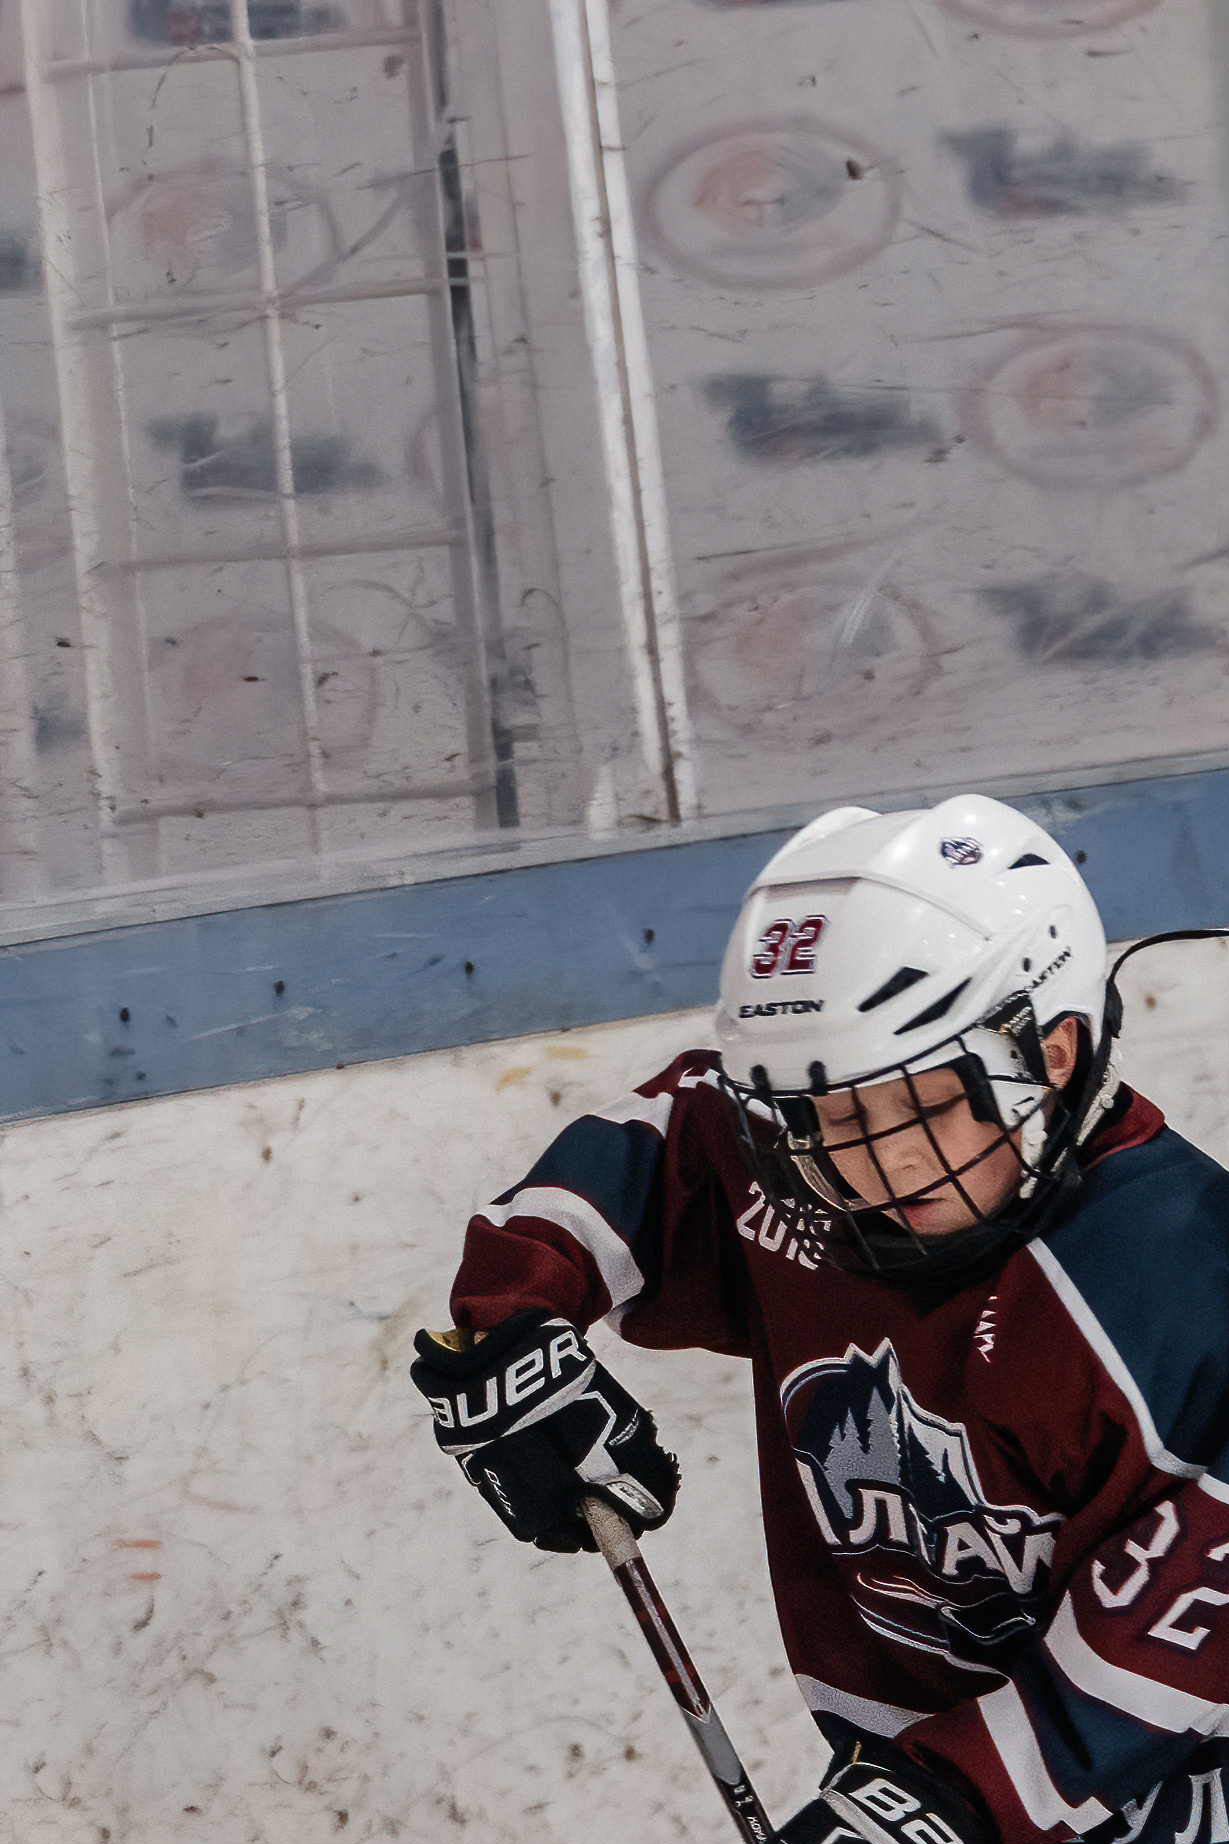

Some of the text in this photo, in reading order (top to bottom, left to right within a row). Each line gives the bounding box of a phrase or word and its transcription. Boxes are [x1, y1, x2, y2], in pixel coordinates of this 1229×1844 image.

[750, 914, 830, 979] 32
[739, 999, 825, 1018] EASTON
[428, 1330, 588, 1428] AUER
